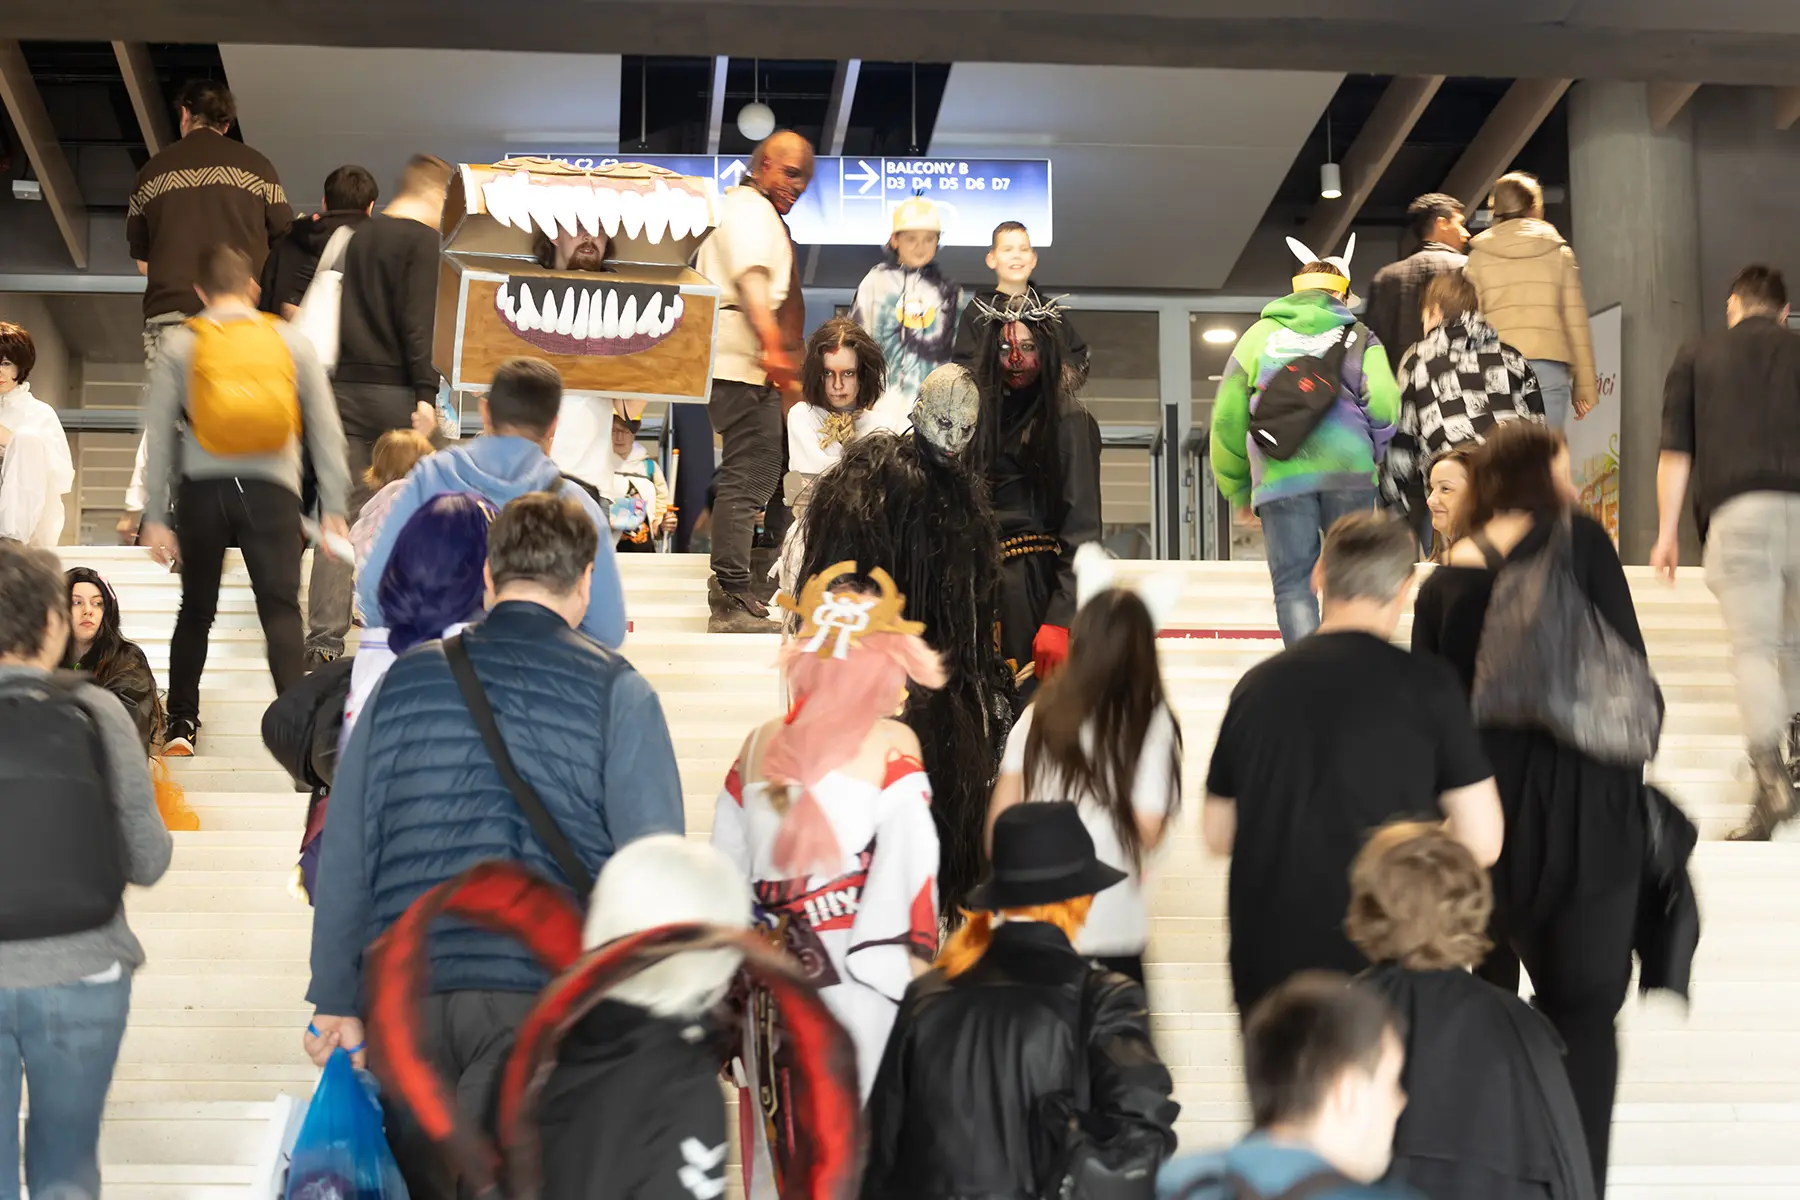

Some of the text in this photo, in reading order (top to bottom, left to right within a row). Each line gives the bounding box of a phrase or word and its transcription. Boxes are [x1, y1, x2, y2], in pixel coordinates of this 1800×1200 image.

[886, 162, 969, 175] BALCONY B
[886, 177, 1011, 190] D3 D4 D5 D6 D7
